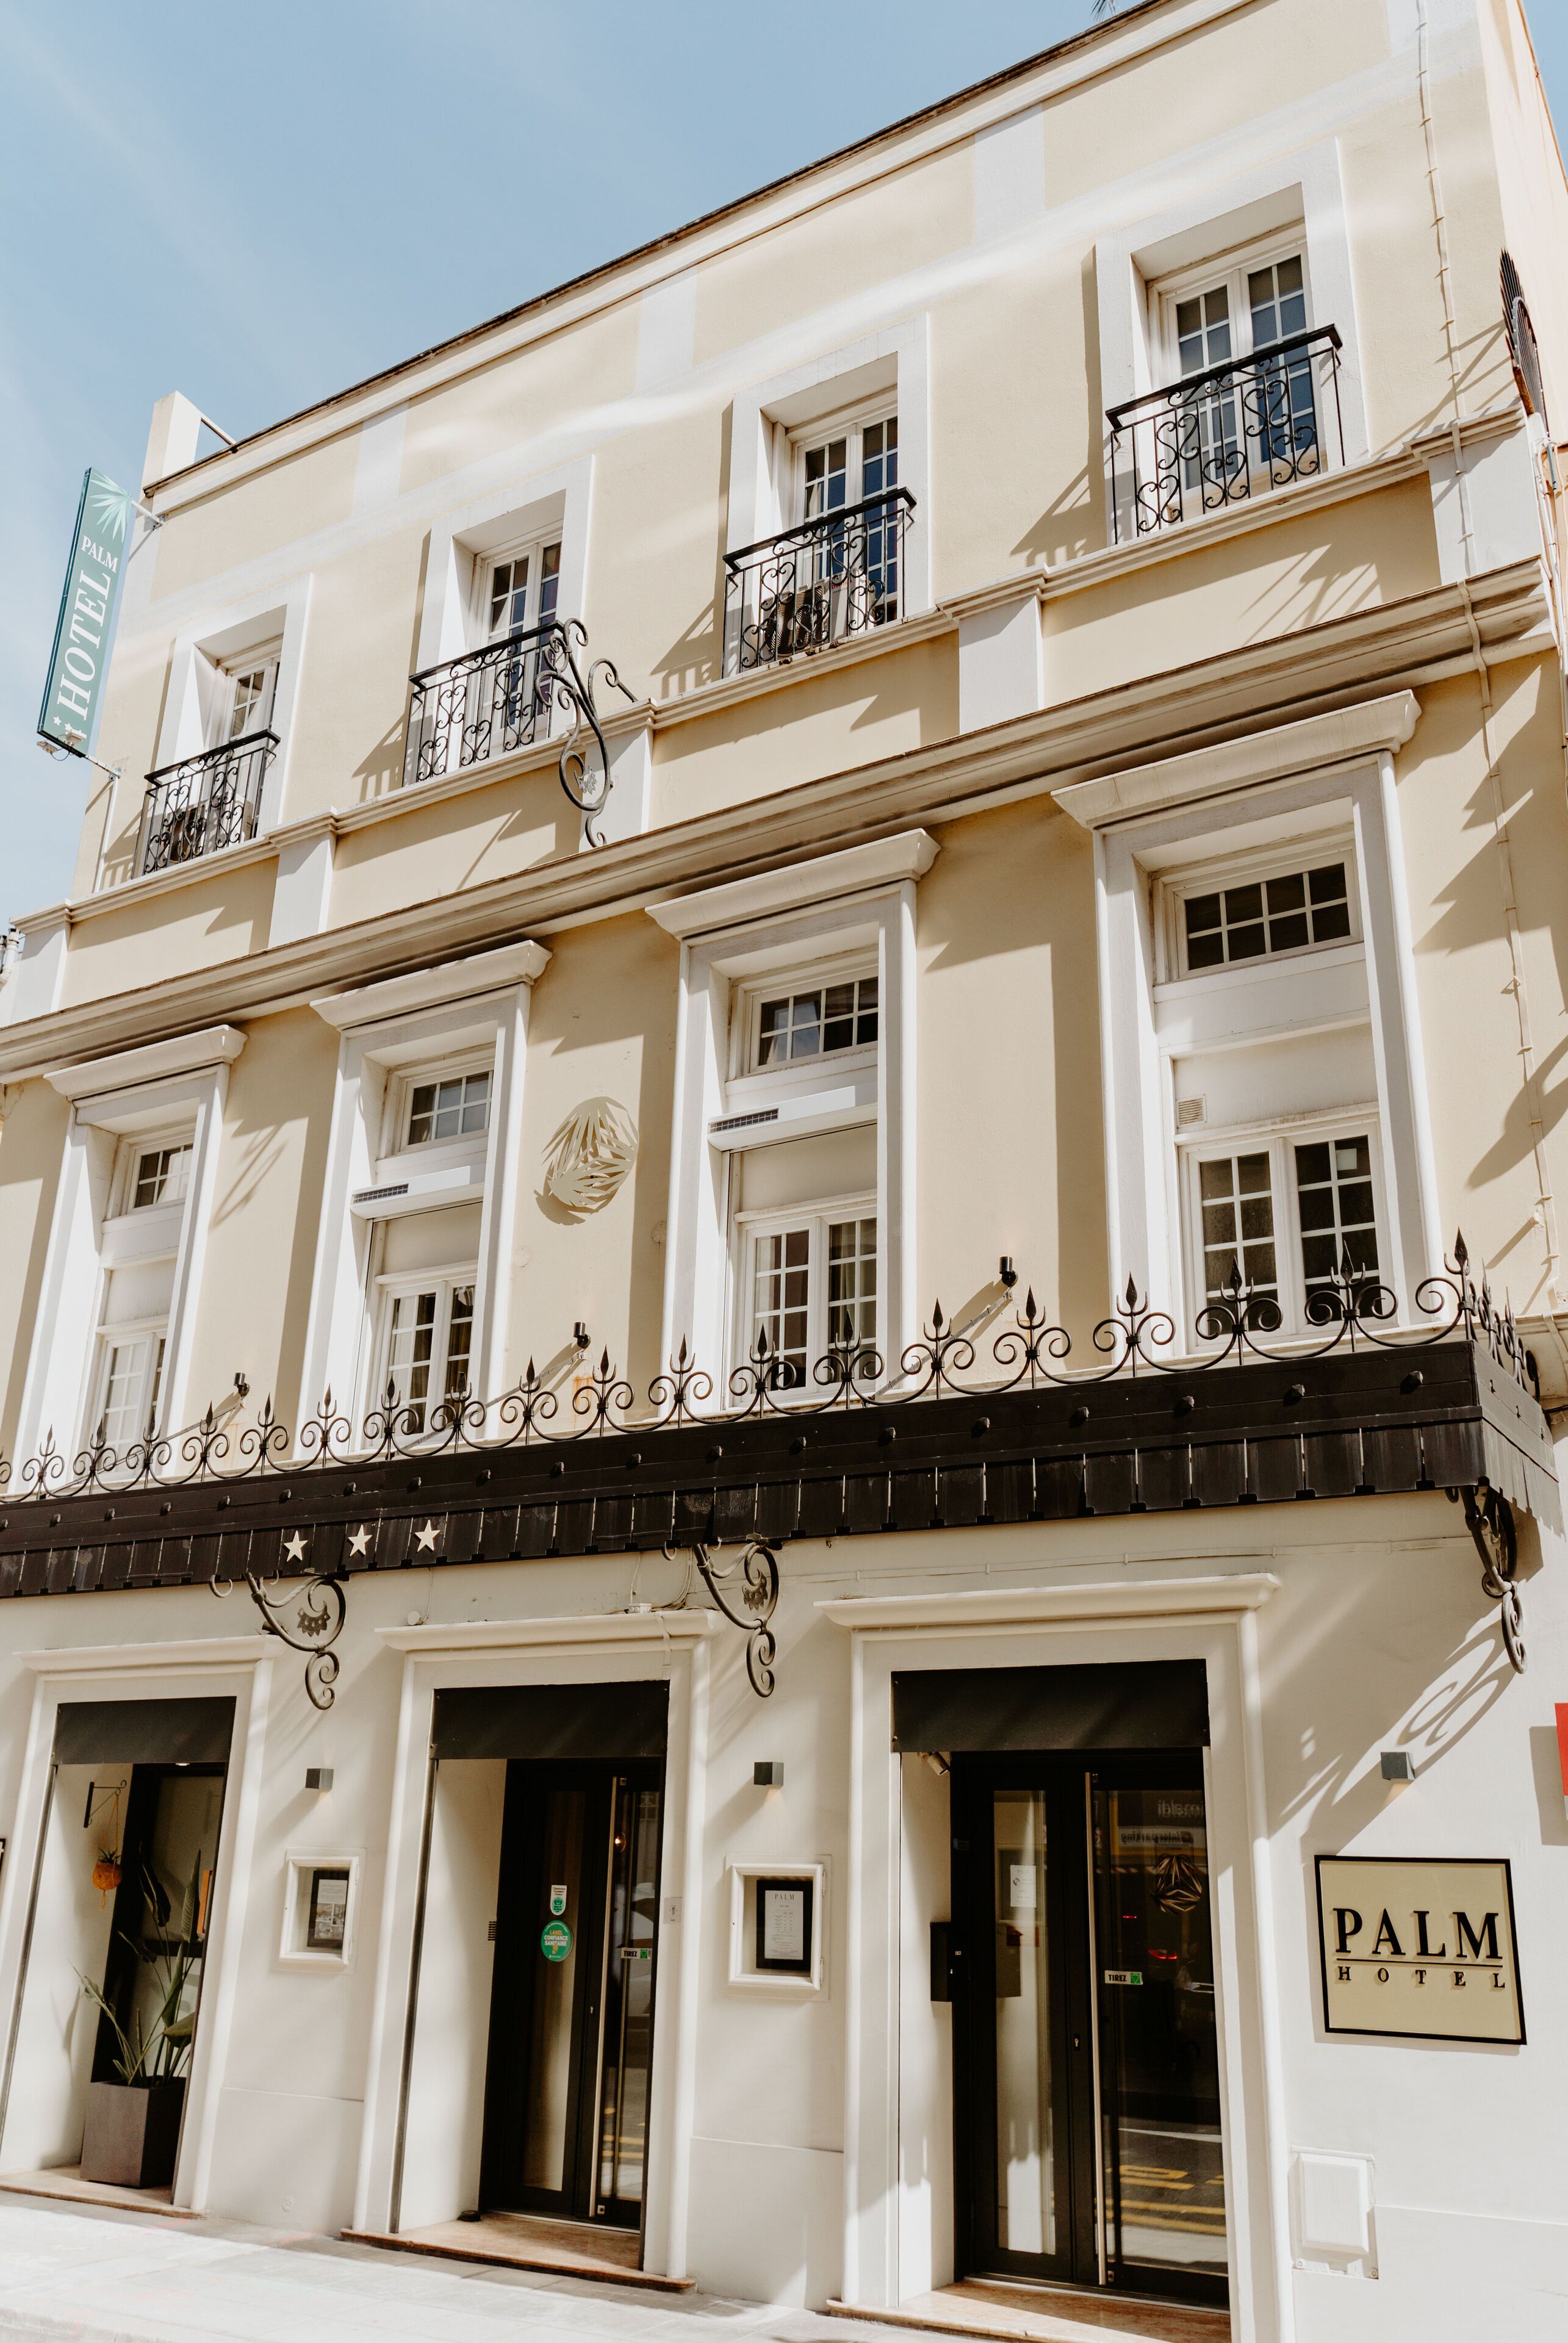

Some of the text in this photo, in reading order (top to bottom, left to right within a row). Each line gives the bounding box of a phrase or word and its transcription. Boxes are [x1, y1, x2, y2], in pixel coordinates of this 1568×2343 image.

[81, 534, 118, 573] PALM
[57, 570, 111, 721] HOTEL
[1332, 1907, 1503, 1959] PALM
[1337, 1966, 1505, 1988] HOTEL
